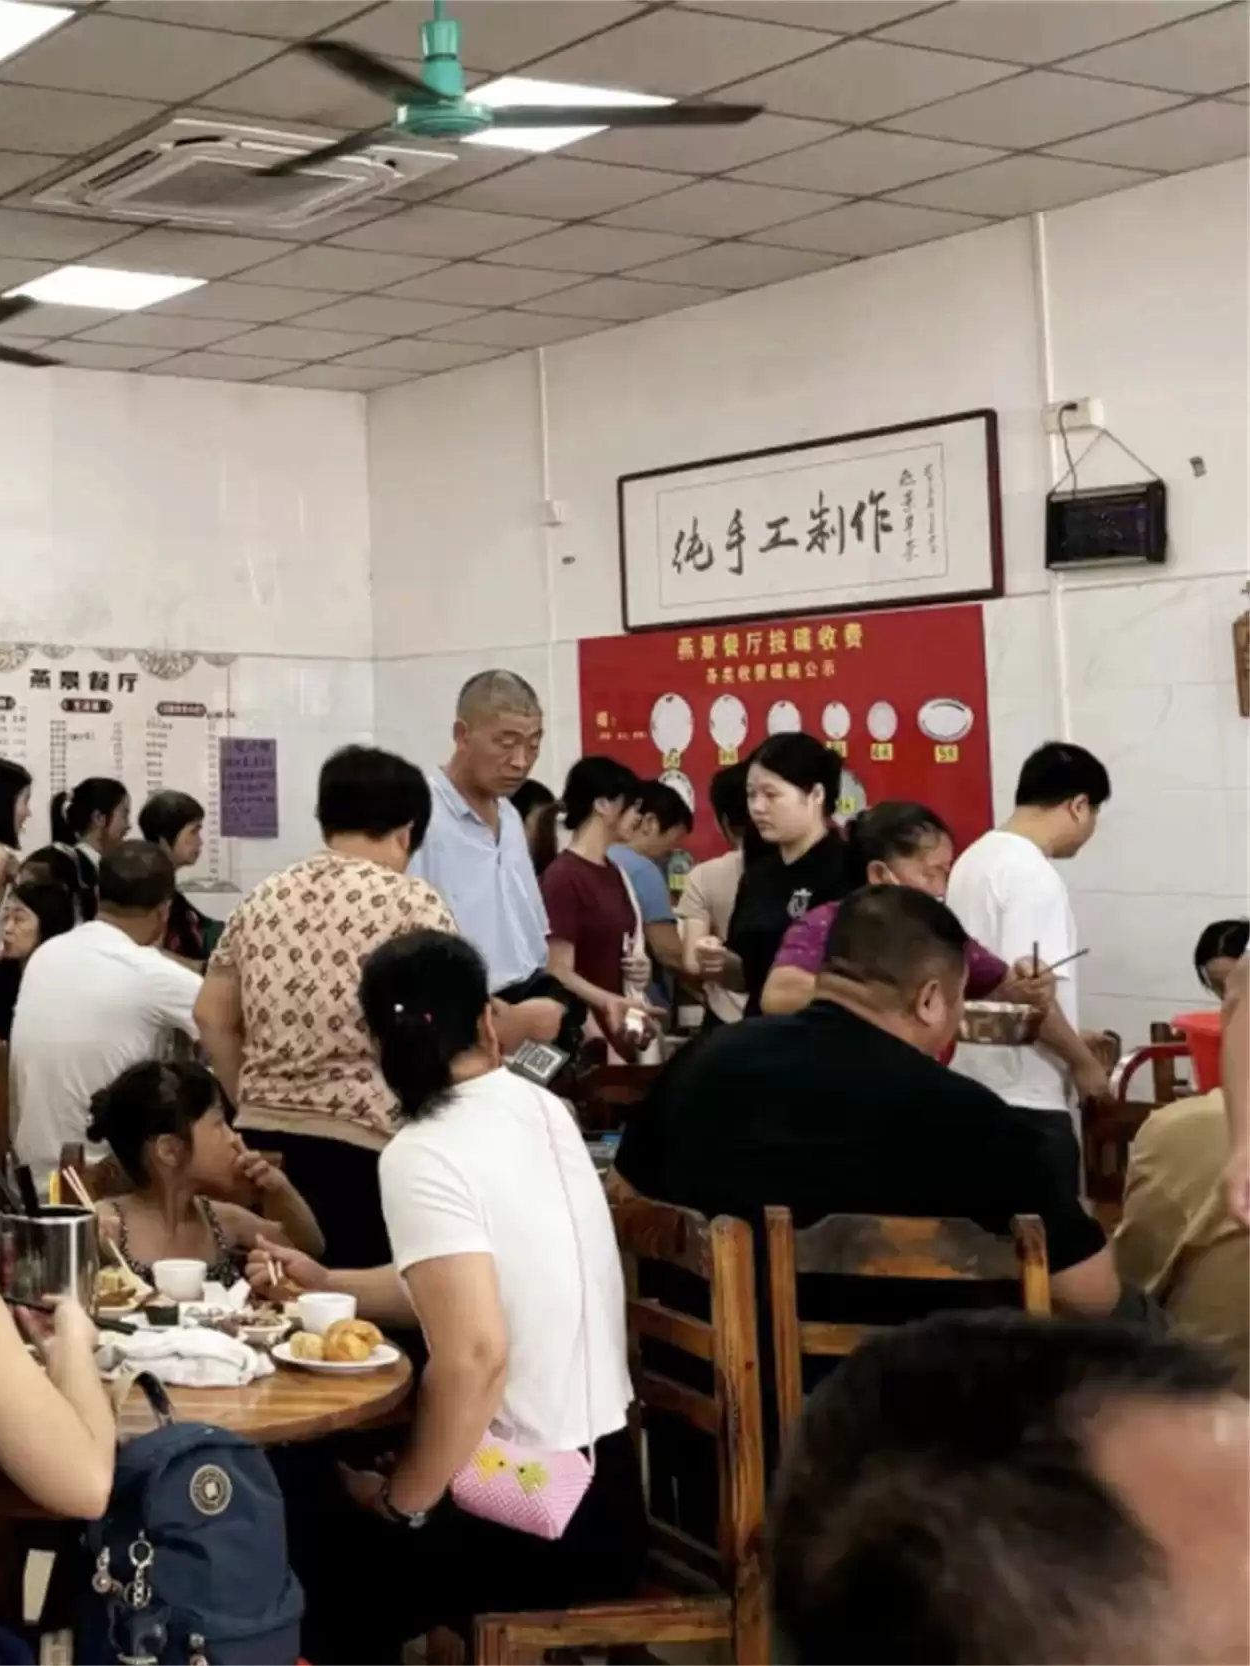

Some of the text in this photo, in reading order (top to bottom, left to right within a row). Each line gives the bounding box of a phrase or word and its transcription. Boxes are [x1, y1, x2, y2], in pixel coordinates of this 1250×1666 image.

[671, 489, 894, 576] 纯手工制作
[29, 668, 139, 693] 燕景餐厅
